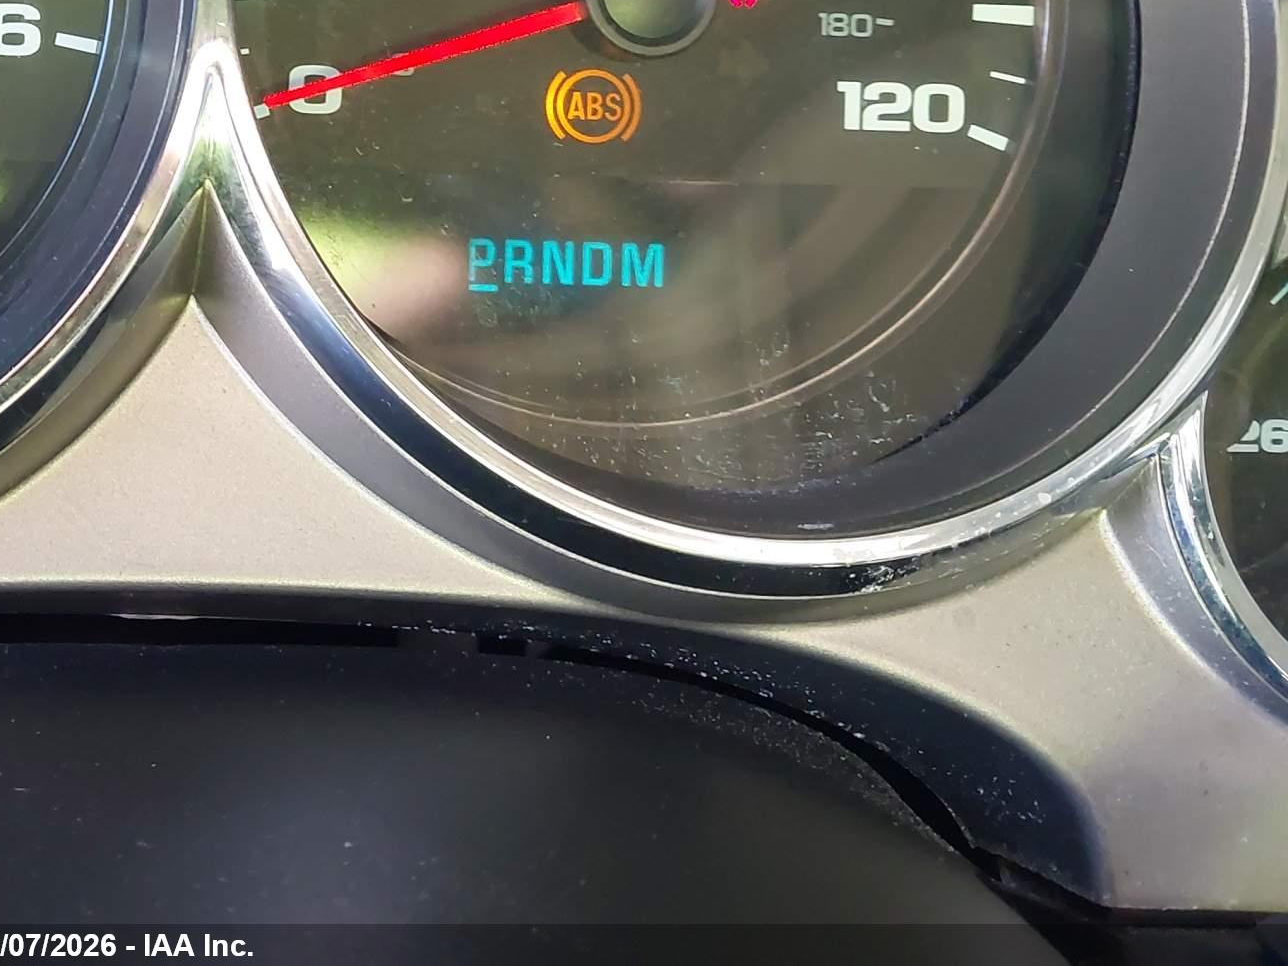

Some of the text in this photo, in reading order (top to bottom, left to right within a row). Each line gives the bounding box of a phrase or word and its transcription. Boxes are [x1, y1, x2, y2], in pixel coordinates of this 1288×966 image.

[818, 12, 873, 38] 180
[288, 64, 343, 115] 0
[567, 91, 622, 121] ABS
[836, 81, 965, 133] 120
